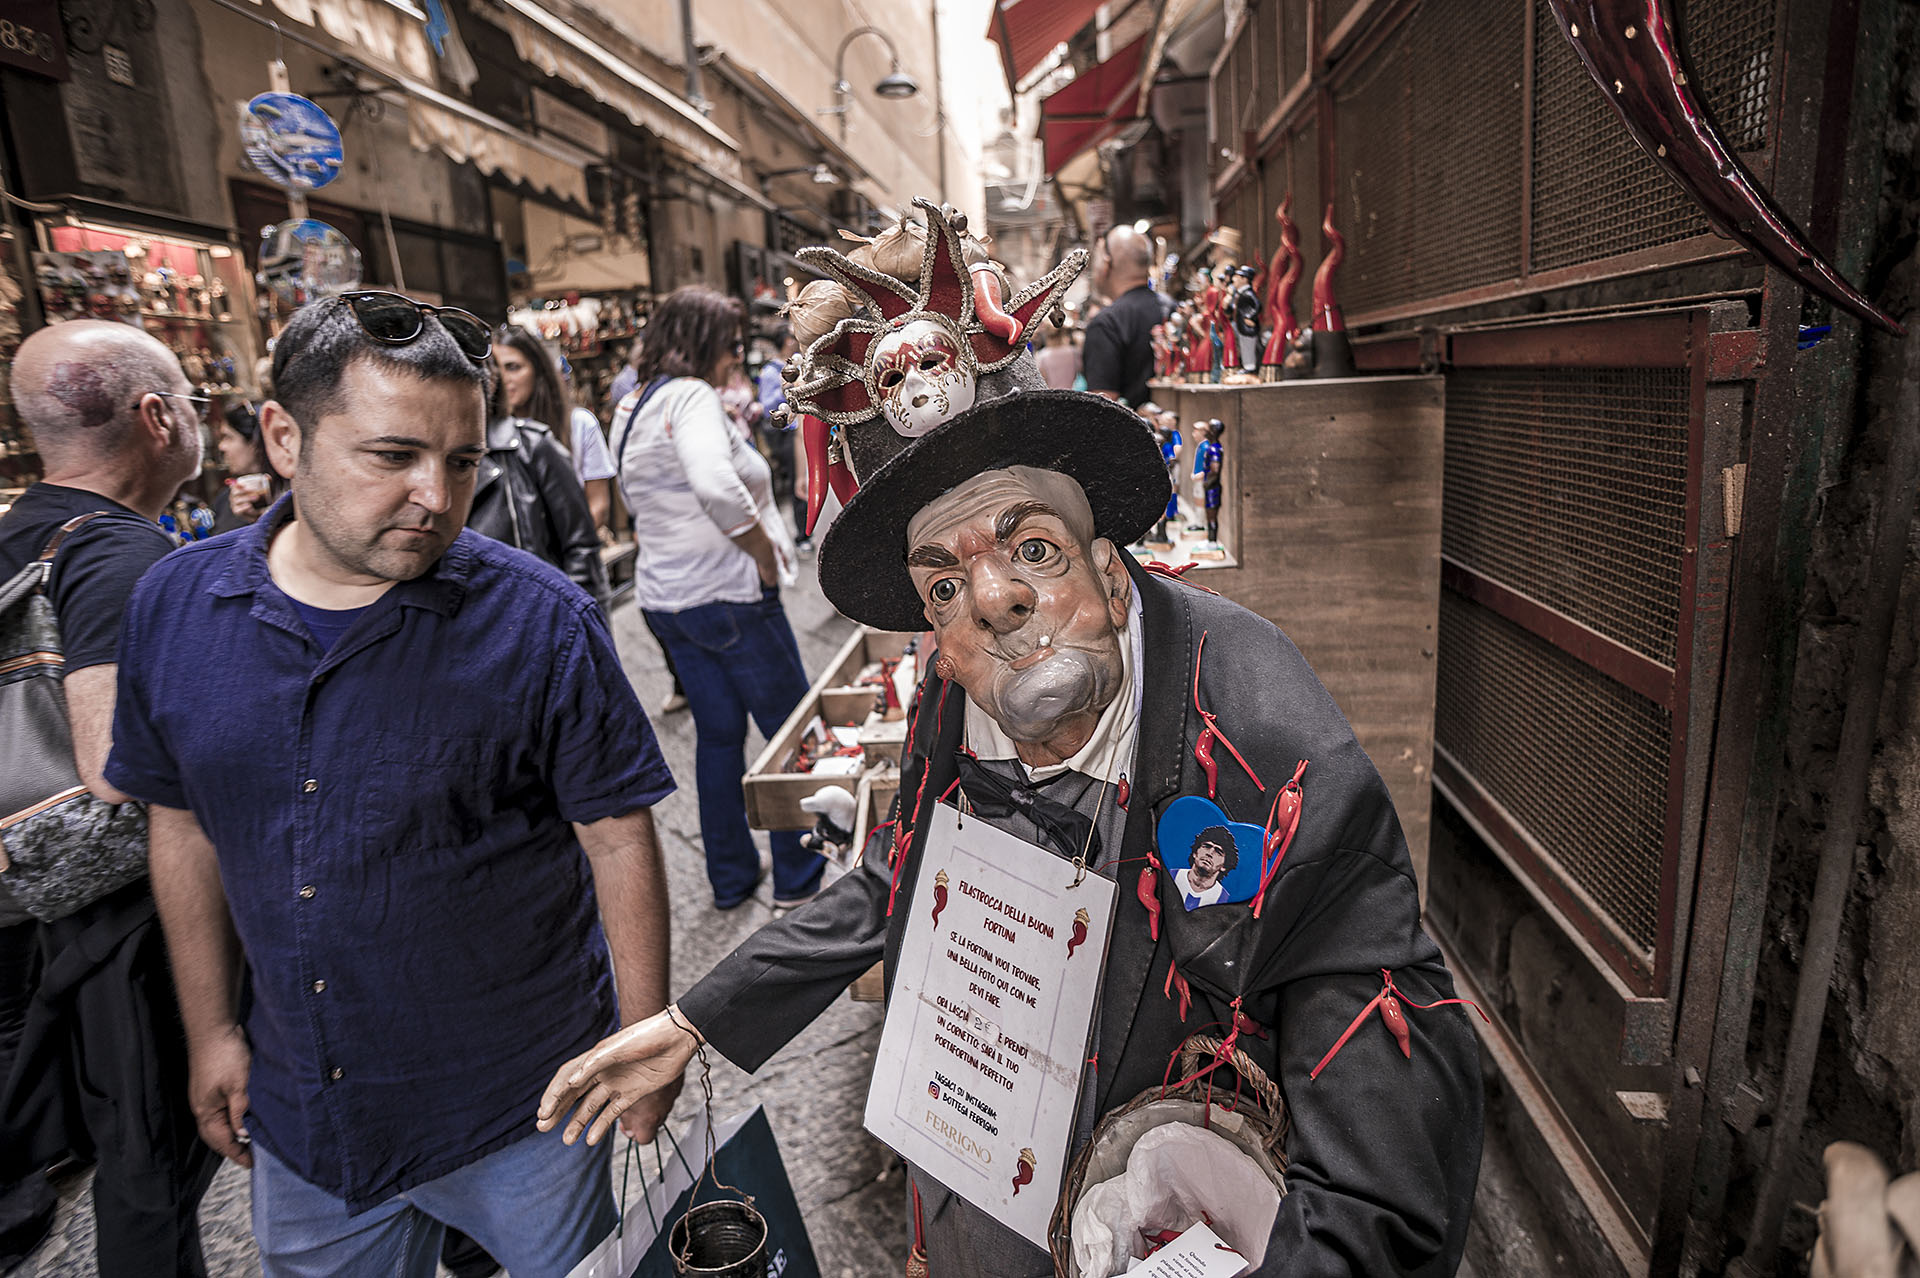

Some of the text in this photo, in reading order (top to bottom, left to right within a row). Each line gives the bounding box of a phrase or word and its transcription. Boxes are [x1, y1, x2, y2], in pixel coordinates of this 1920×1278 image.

[958, 880, 1054, 939] FILASTROCCA DELLA BUONA
[983, 917, 1016, 944] FORTUNA
[946, 949, 1037, 1009] UNA BELLA FOTO QUI CON ME
[950, 931, 1041, 991] SE LA FORTUNA VUOI TROVARE,
[936, 995, 970, 1022] ORA LASCIA
[969, 982, 985, 999] DEVI
[934, 1033, 1014, 1093] PORTAFORTUNA PERFETTO!
[937, 1015, 946, 1028] UN
[997, 1052, 1003, 1065] IL
[1005, 1057, 1019, 1074] TUO
[998, 1032, 1029, 1060] E PRENDI
[934, 1070, 957, 1093] TAGGACI
[957, 1086, 965, 1097] SU
[925, 1109, 992, 1164] FERRIGNO
[942, 1092, 999, 1137] BOTTEGA FERRIGNO
